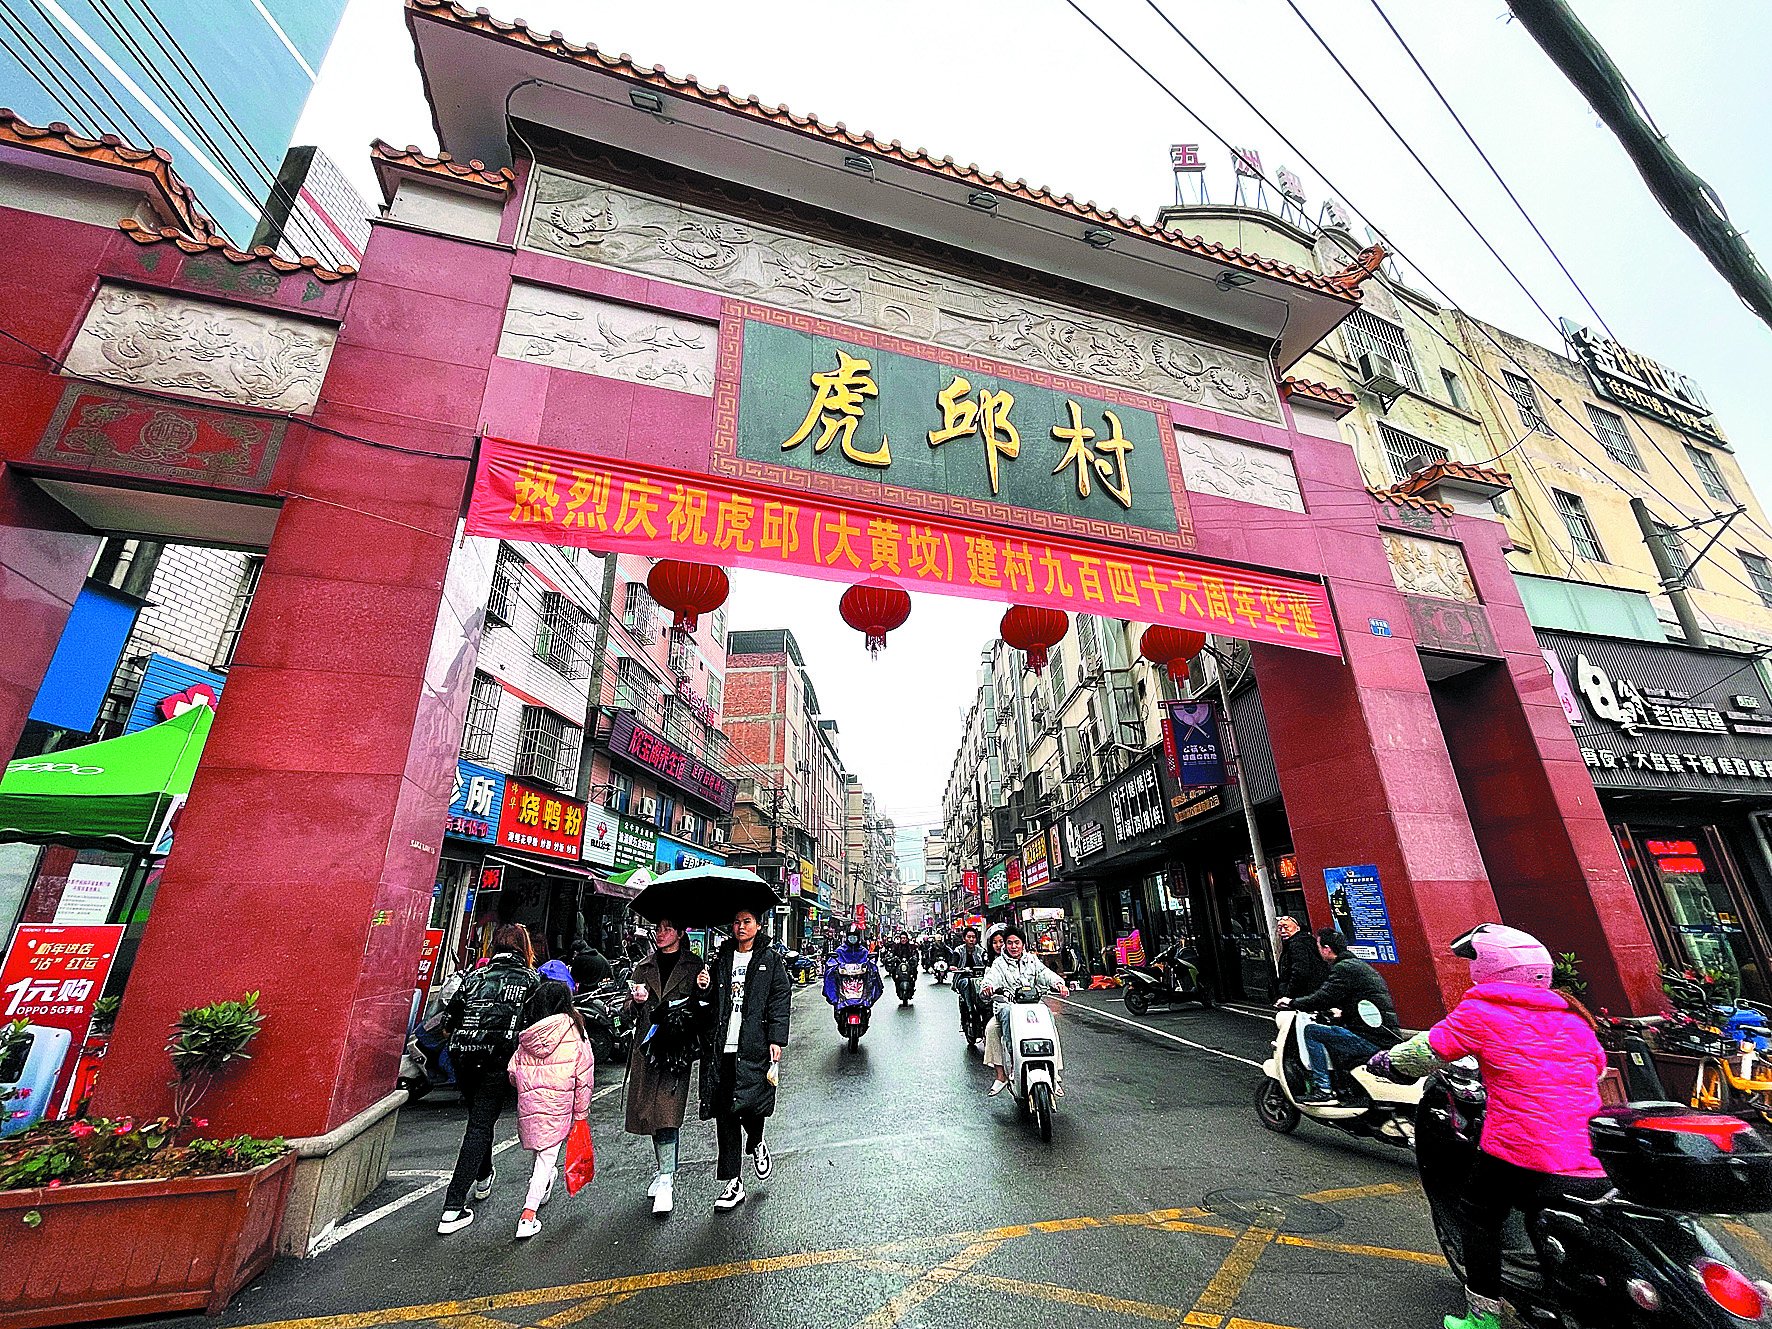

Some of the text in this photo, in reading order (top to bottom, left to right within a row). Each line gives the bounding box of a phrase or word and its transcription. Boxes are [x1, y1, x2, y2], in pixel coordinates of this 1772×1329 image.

[781, 349, 1134, 508] 虎邱村
[518, 790, 582, 836] 烧鸭粉
[482, 869, 500, 889] 粥
[34, 943, 95, 955] 新年进店
[4, 977, 94, 1016] 1元购
[16, 1006, 49, 1015] OPPO
